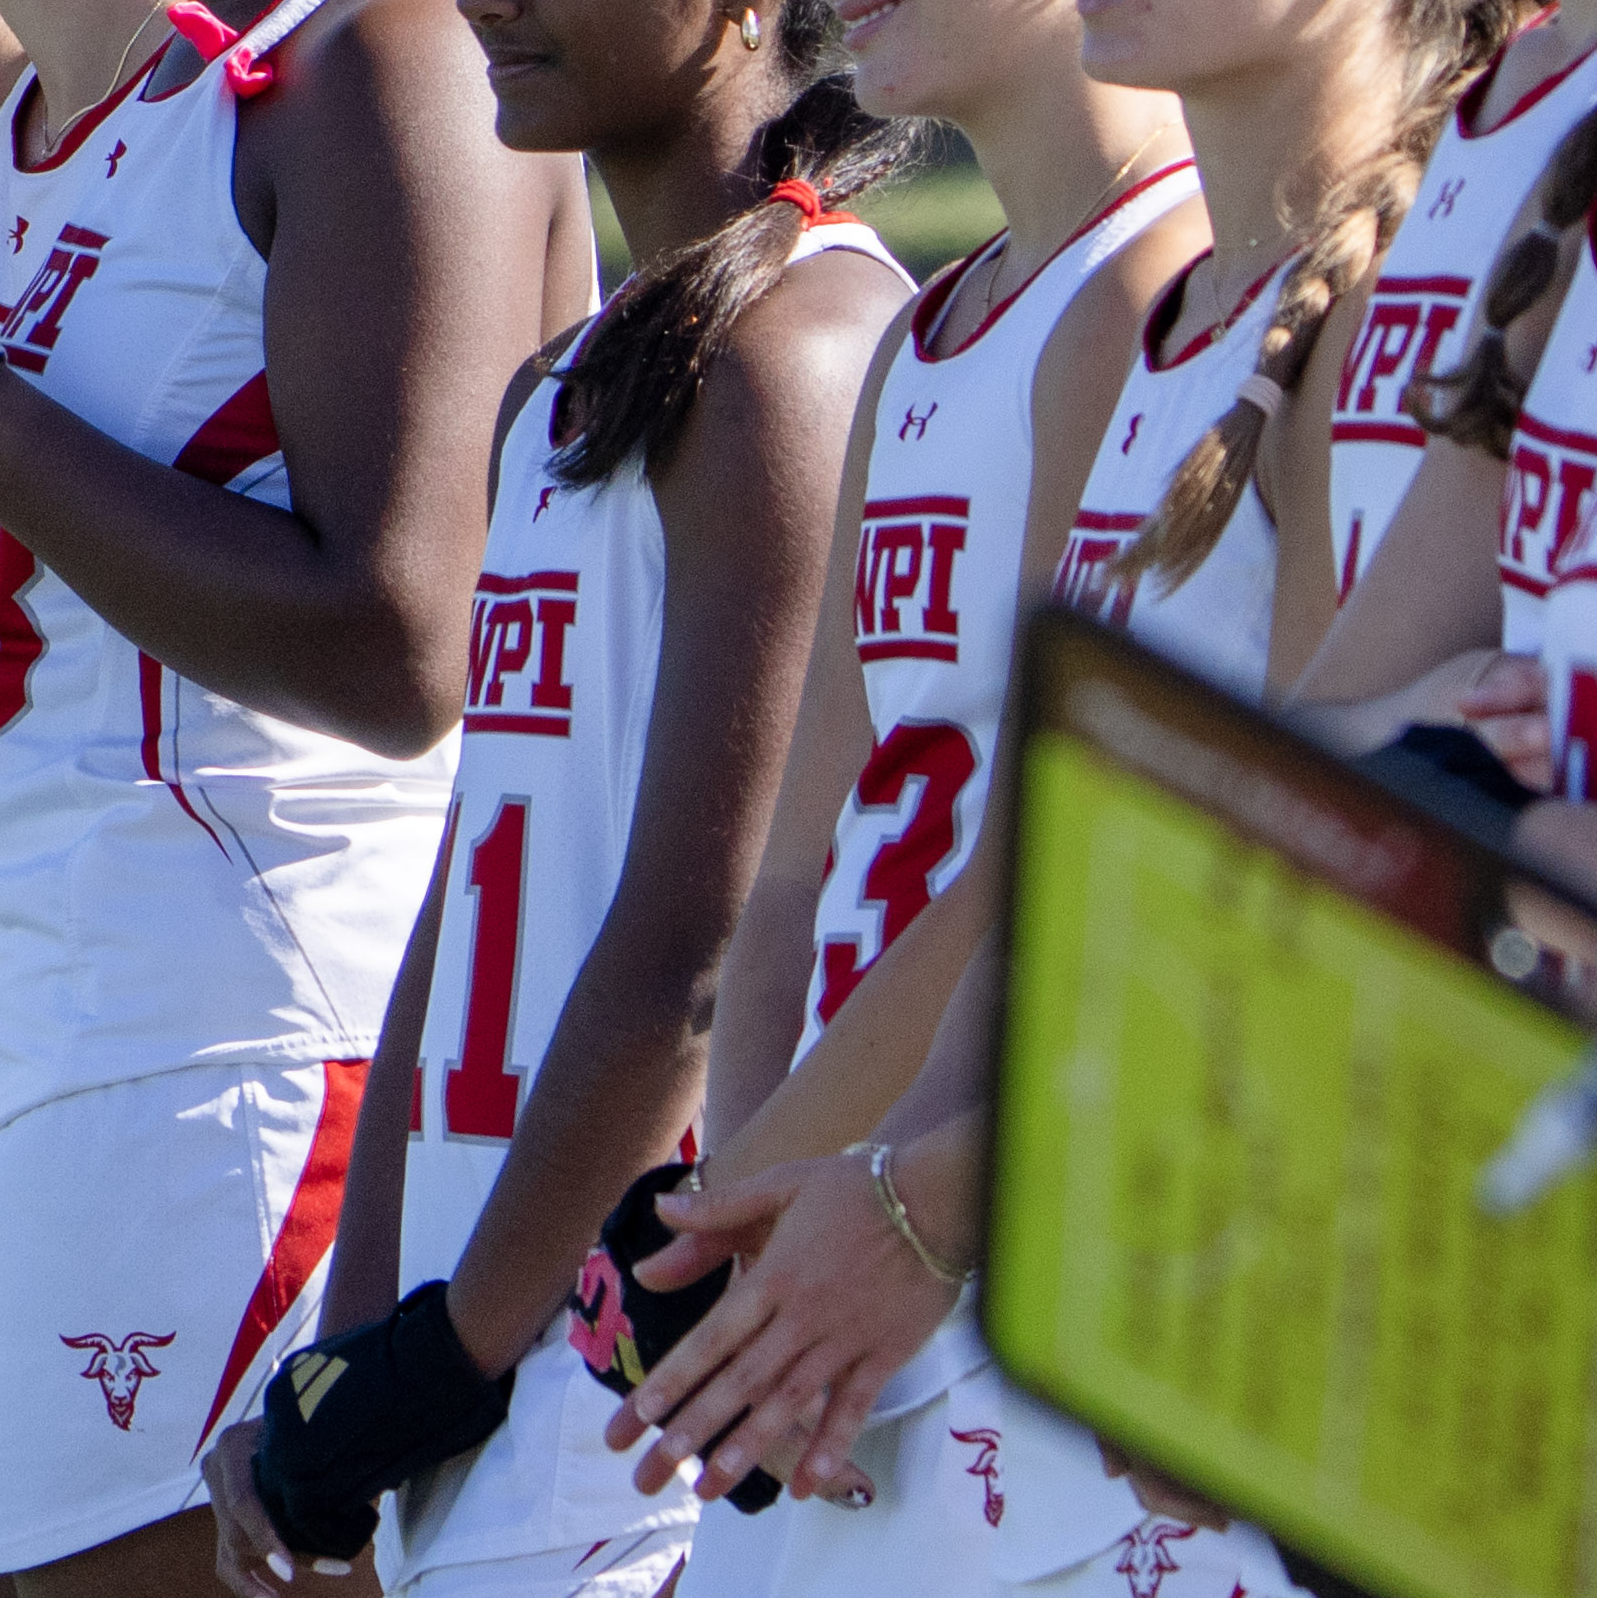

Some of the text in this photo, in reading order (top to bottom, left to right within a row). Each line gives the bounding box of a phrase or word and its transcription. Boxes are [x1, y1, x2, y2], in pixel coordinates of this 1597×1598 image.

[0, 247, 101, 350] PI
[1500, 444, 1597, 576] PI
[407, 791, 532, 1148] 1
[812, 714, 984, 1030] 3
